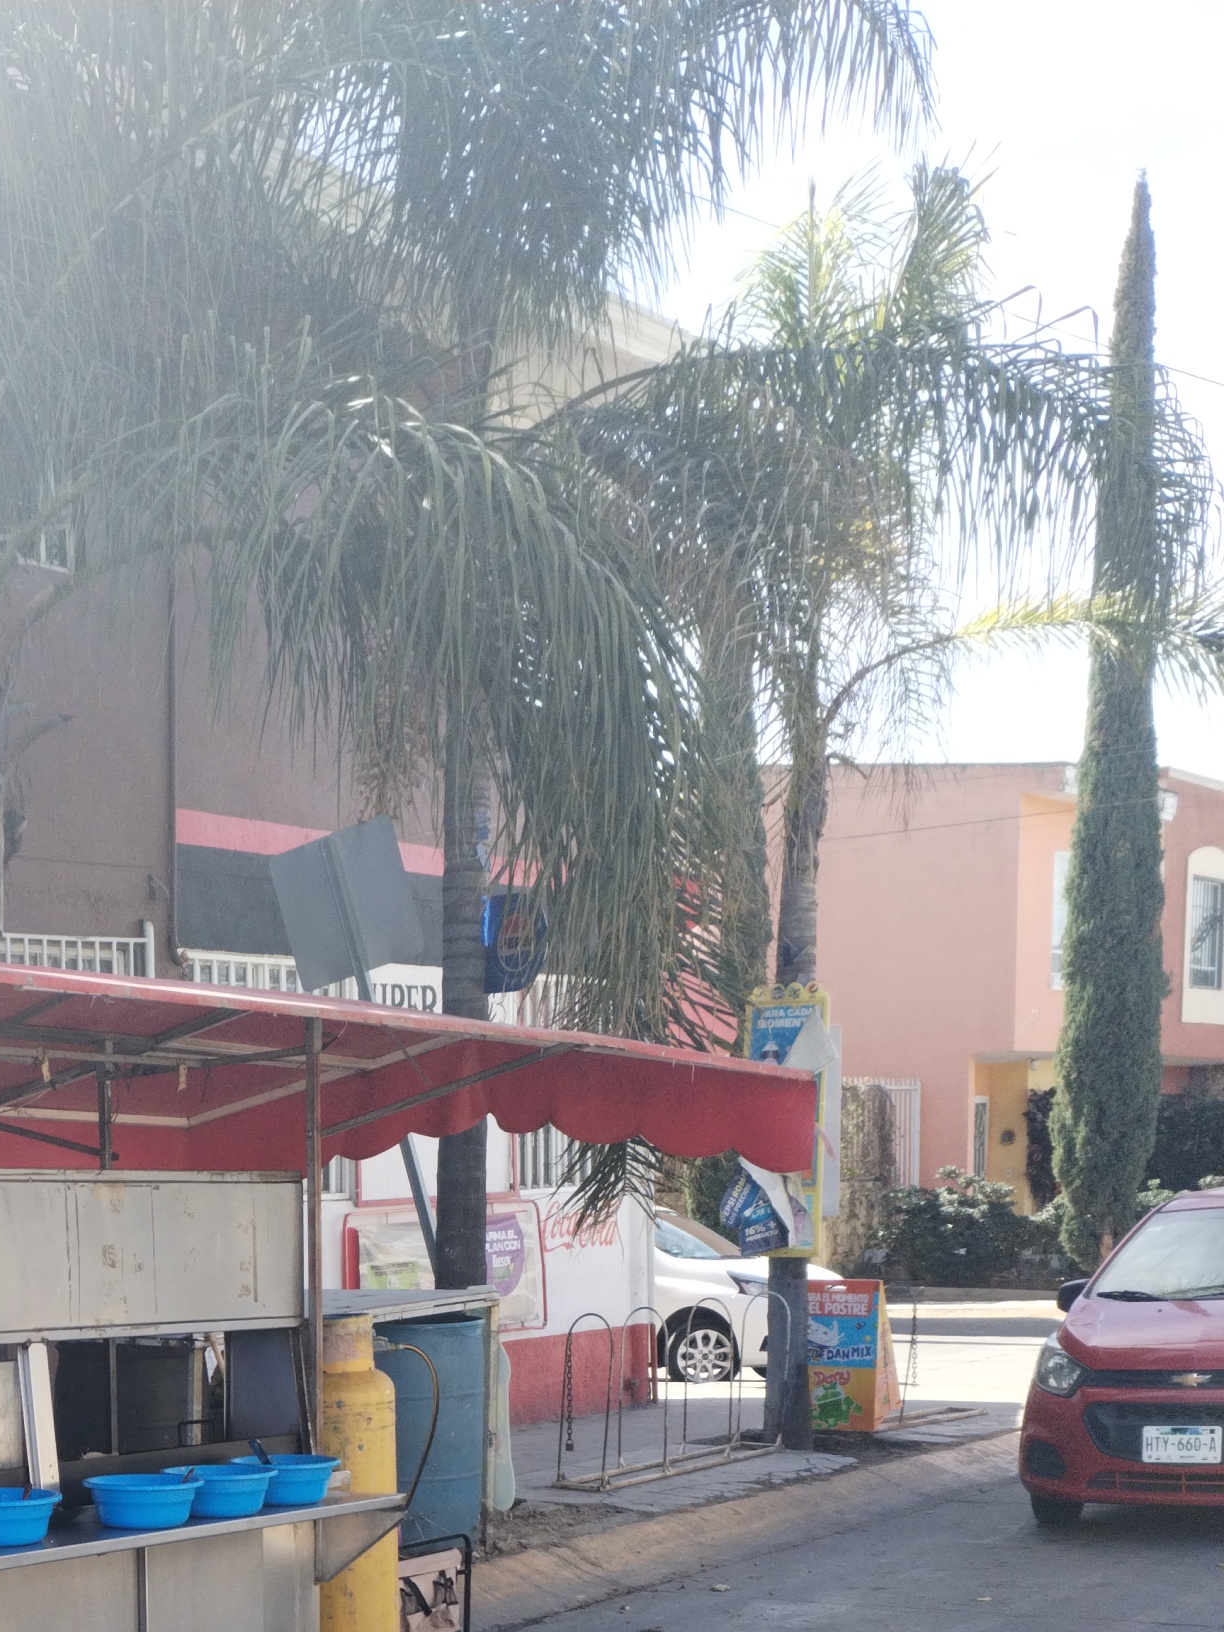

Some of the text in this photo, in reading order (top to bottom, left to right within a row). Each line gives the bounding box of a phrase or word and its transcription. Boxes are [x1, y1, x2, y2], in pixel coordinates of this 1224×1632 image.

[373, 983, 437, 1014] UPER
[541, 1197, 620, 1252] CocaCola
[808, 1292, 821, 1302] ARA
[824, 1302, 868, 1316] POSTRE
[1146, 1436, 1216, 1452] HTY-660-A
